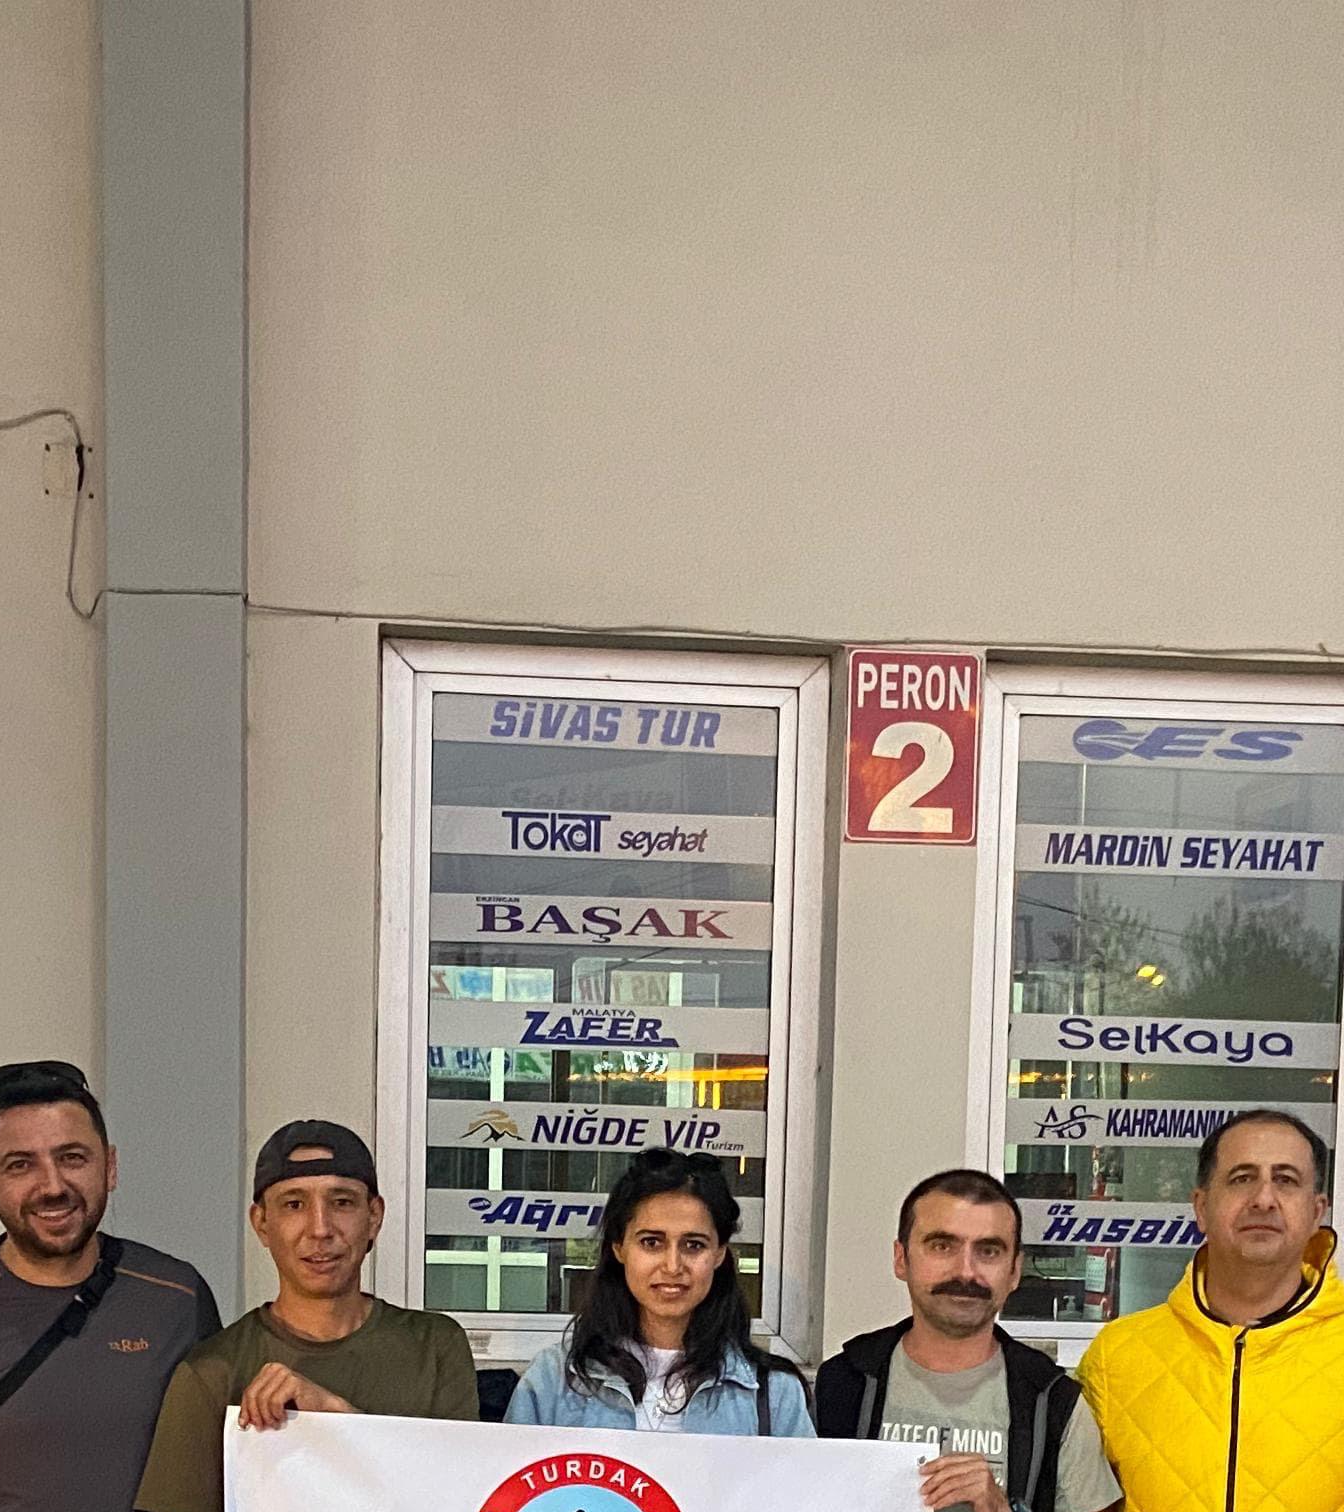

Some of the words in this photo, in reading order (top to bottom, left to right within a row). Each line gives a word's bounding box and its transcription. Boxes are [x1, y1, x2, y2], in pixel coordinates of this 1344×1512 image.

[857, 663, 971, 711] PERON
[636, 709, 721, 748] TUR
[868, 722, 955, 835] 2
[618, 826, 708, 857] seyahat
[1179, 837, 1324, 872] SEYAHAT
[476, 904, 734, 943] BAŞAK
[520, 1011, 680, 1047] ZAFER
[573, 1008, 636, 1018] MALATYA
[531, 1107, 649, 1147] NİĞDE
[663, 1114, 721, 1149] VİP
[1105, 1108, 1243, 1138] KAHRAMANM
[882, 1422, 924, 1442] TATE
[952, 1428, 1002, 1454] MIND
[520, 1460, 650, 1498] TURDAK
